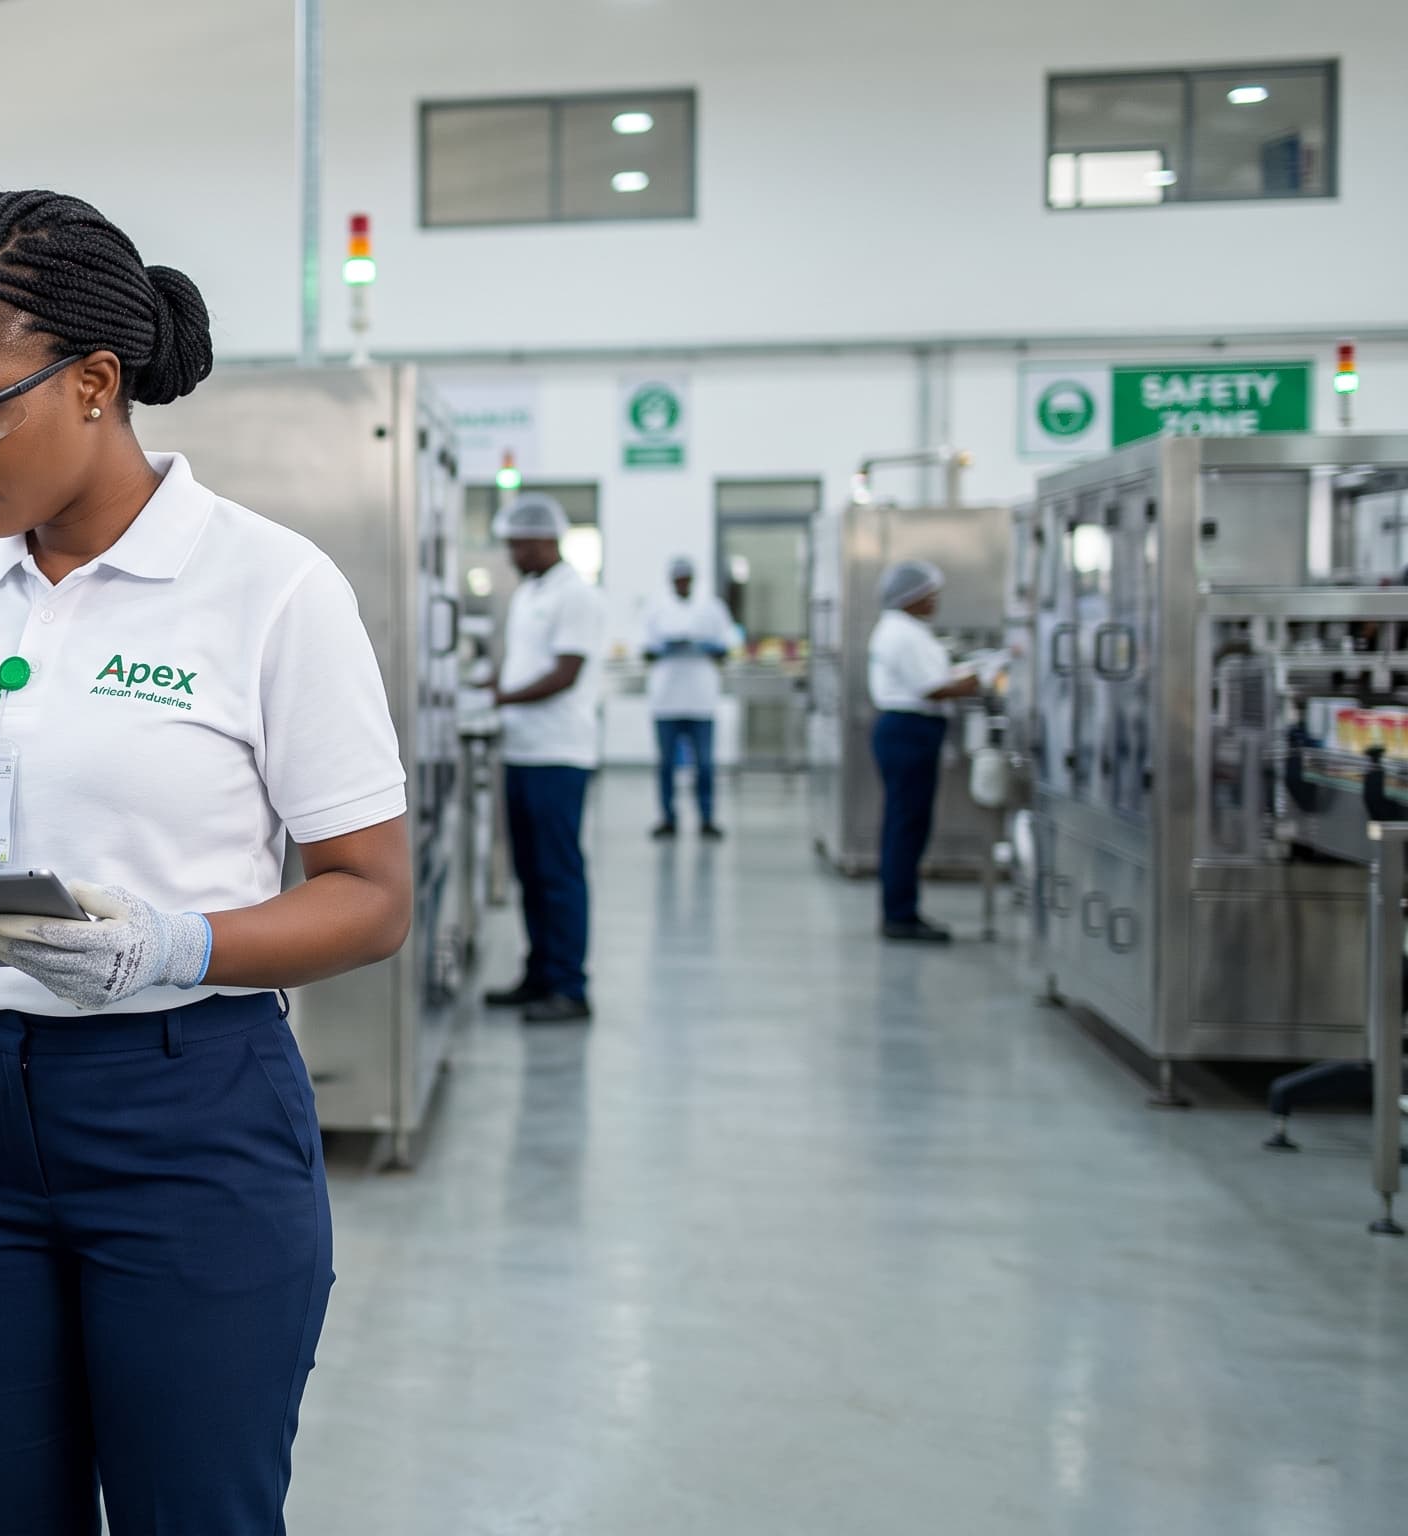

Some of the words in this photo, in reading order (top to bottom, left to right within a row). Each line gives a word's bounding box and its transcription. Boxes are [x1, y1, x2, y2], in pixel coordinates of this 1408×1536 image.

[1140, 374, 1278, 409] SAFETY
[1159, 409, 1259, 437] ZONE
[96, 655, 198, 695] Apex
[90, 686, 132, 698] African
[134, 690, 192, 711] Industries
